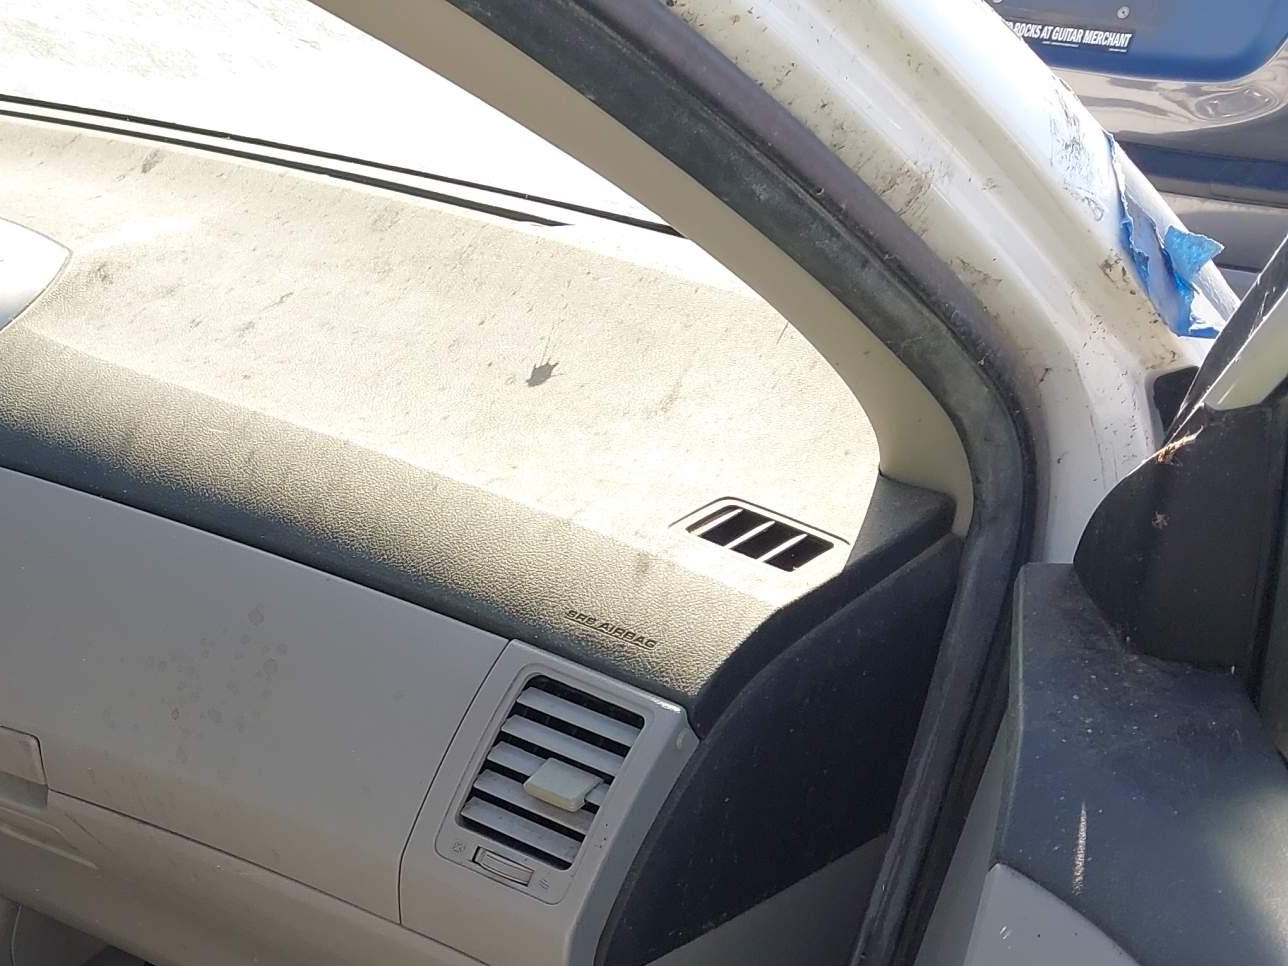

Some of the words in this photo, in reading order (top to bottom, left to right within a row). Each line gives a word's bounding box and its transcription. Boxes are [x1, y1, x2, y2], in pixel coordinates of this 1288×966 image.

[1014, 22, 1042, 38] ROCKS
[1039, 25, 1054, 39] AT
[1051, 26, 1084, 43] GUITAR
[1082, 30, 1133, 48] MERCHANT
[566, 609, 598, 625] SRS
[598, 621, 659, 649] AIRBAG
